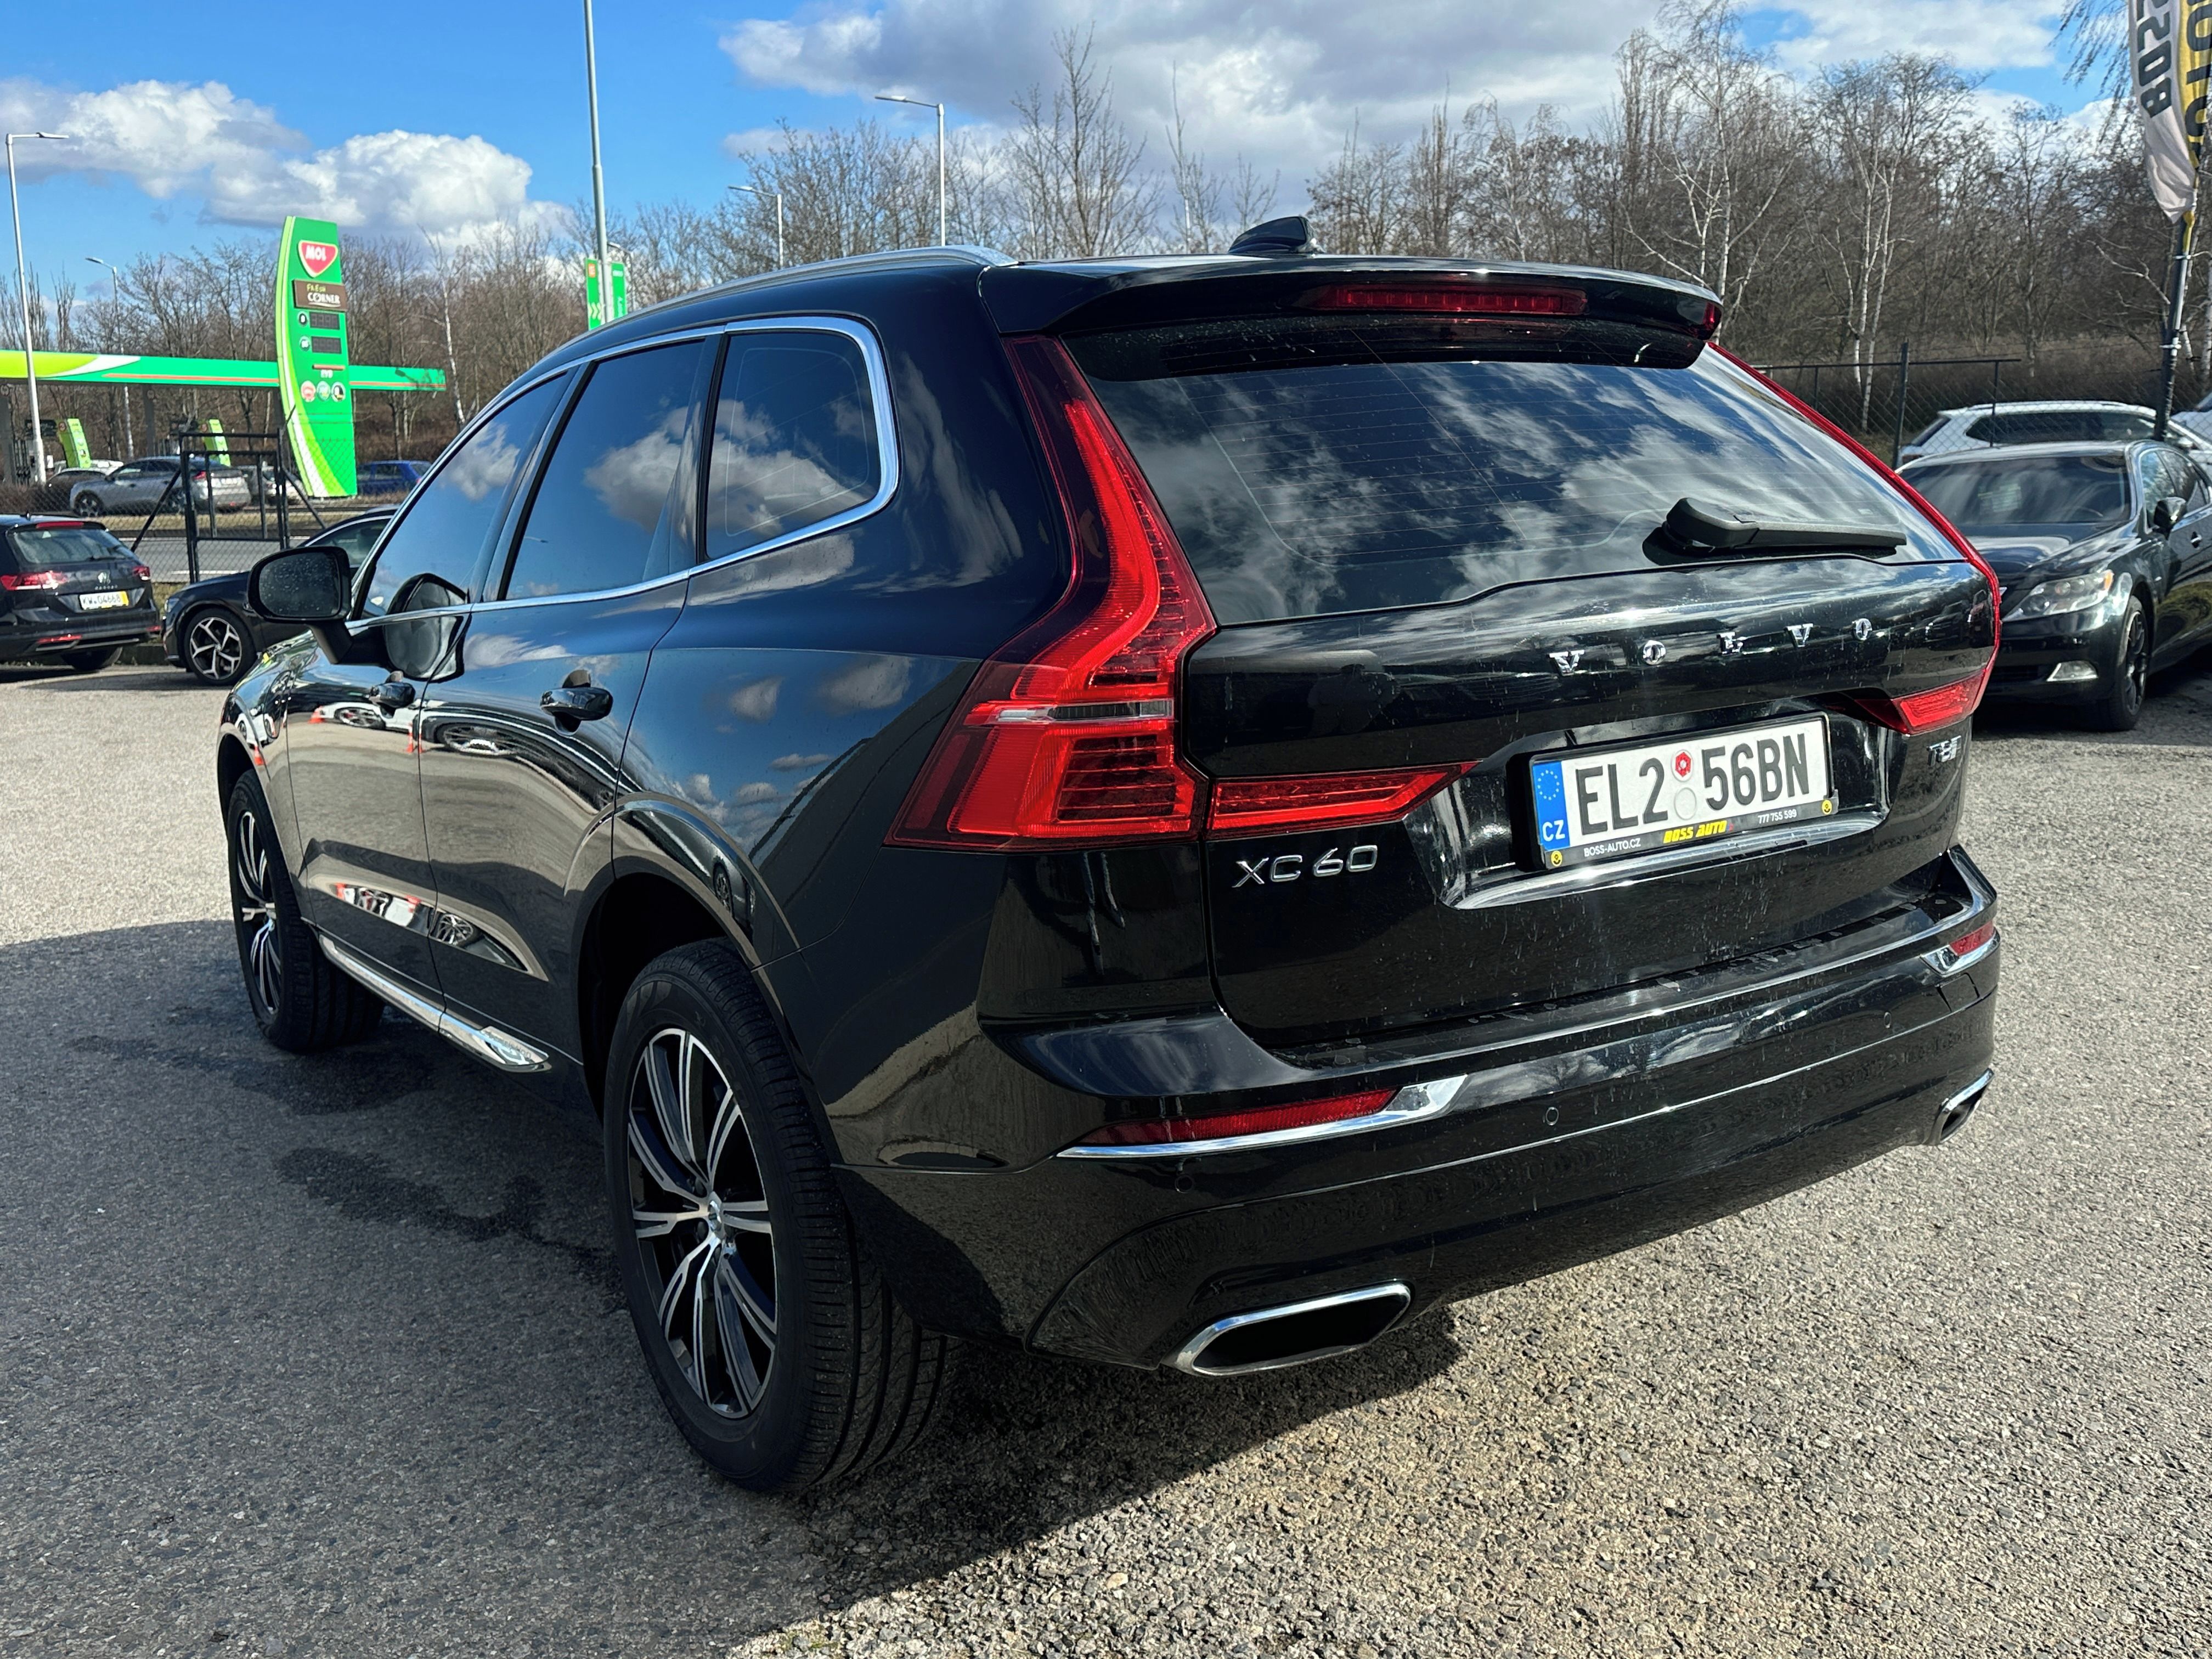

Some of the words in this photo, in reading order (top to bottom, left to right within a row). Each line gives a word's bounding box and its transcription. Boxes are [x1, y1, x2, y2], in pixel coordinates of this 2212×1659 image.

[306, 245, 327, 261] MOL
[1549, 617, 1873, 676] VOLVO
[1575, 757, 1668, 836] EL2
[1701, 732, 1810, 811] 56BN
[1757, 814, 1770, 824] 777
[1770, 811, 1783, 822] 755
[1784, 809, 1797, 820] 599
[1542, 819, 1566, 842] CZ
[1663, 826, 1694, 844] BOSS
[1695, 820, 1728, 838] AUTO
[1583, 837, 1641, 857] BOSS-AUTO.CZ
